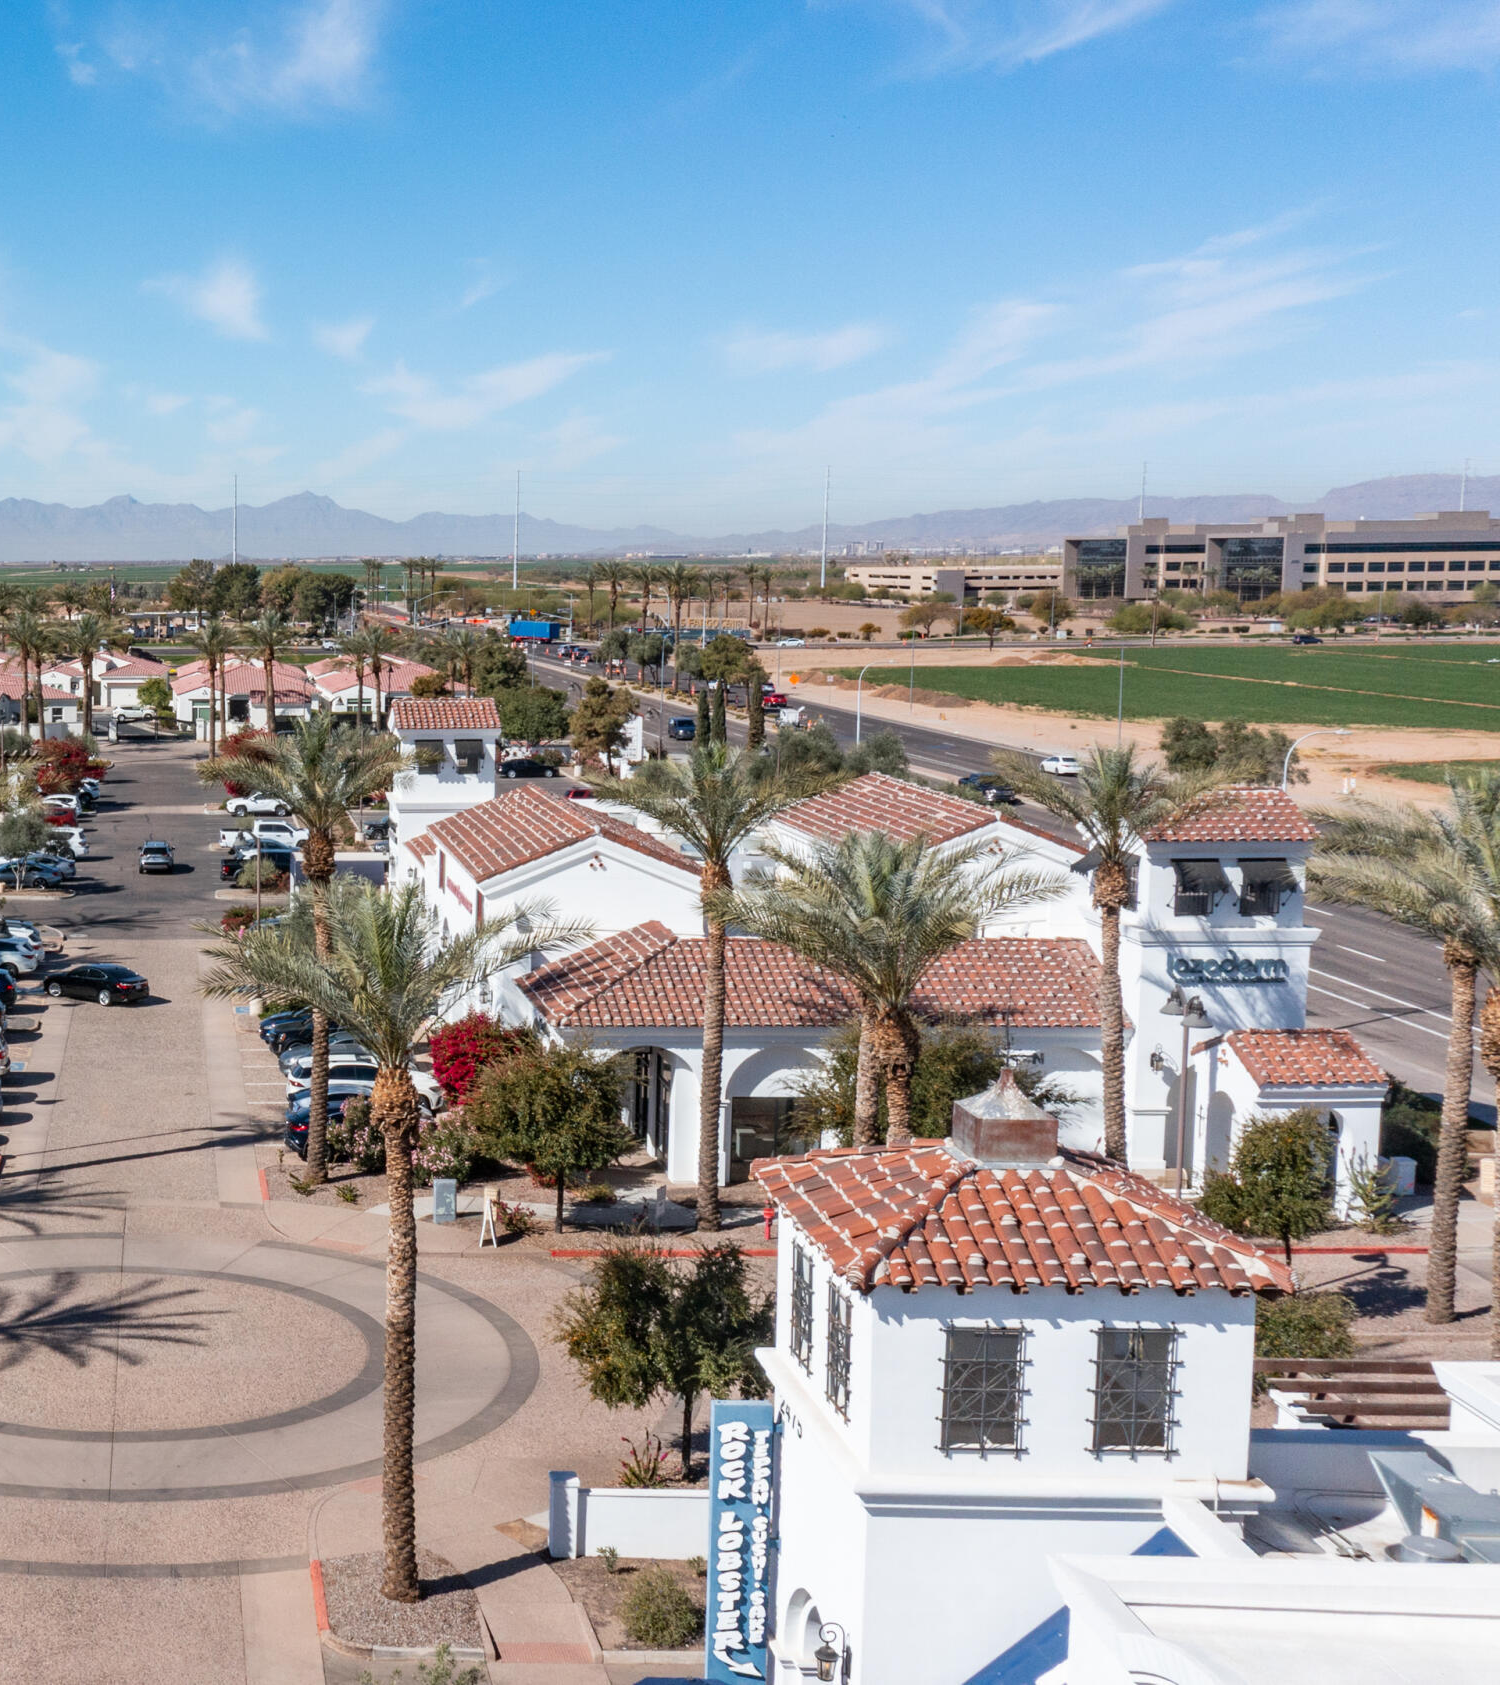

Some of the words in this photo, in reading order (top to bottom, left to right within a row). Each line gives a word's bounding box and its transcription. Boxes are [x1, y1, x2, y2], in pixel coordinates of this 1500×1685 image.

[717, 1421, 750, 1500] ROCK
[752, 1429, 772, 1505] TEPPAN
[712, 1511, 745, 1652] LOBSTER
[751, 1515, 769, 1581] SUSHI
[748, 1590, 766, 1644] SAKE
